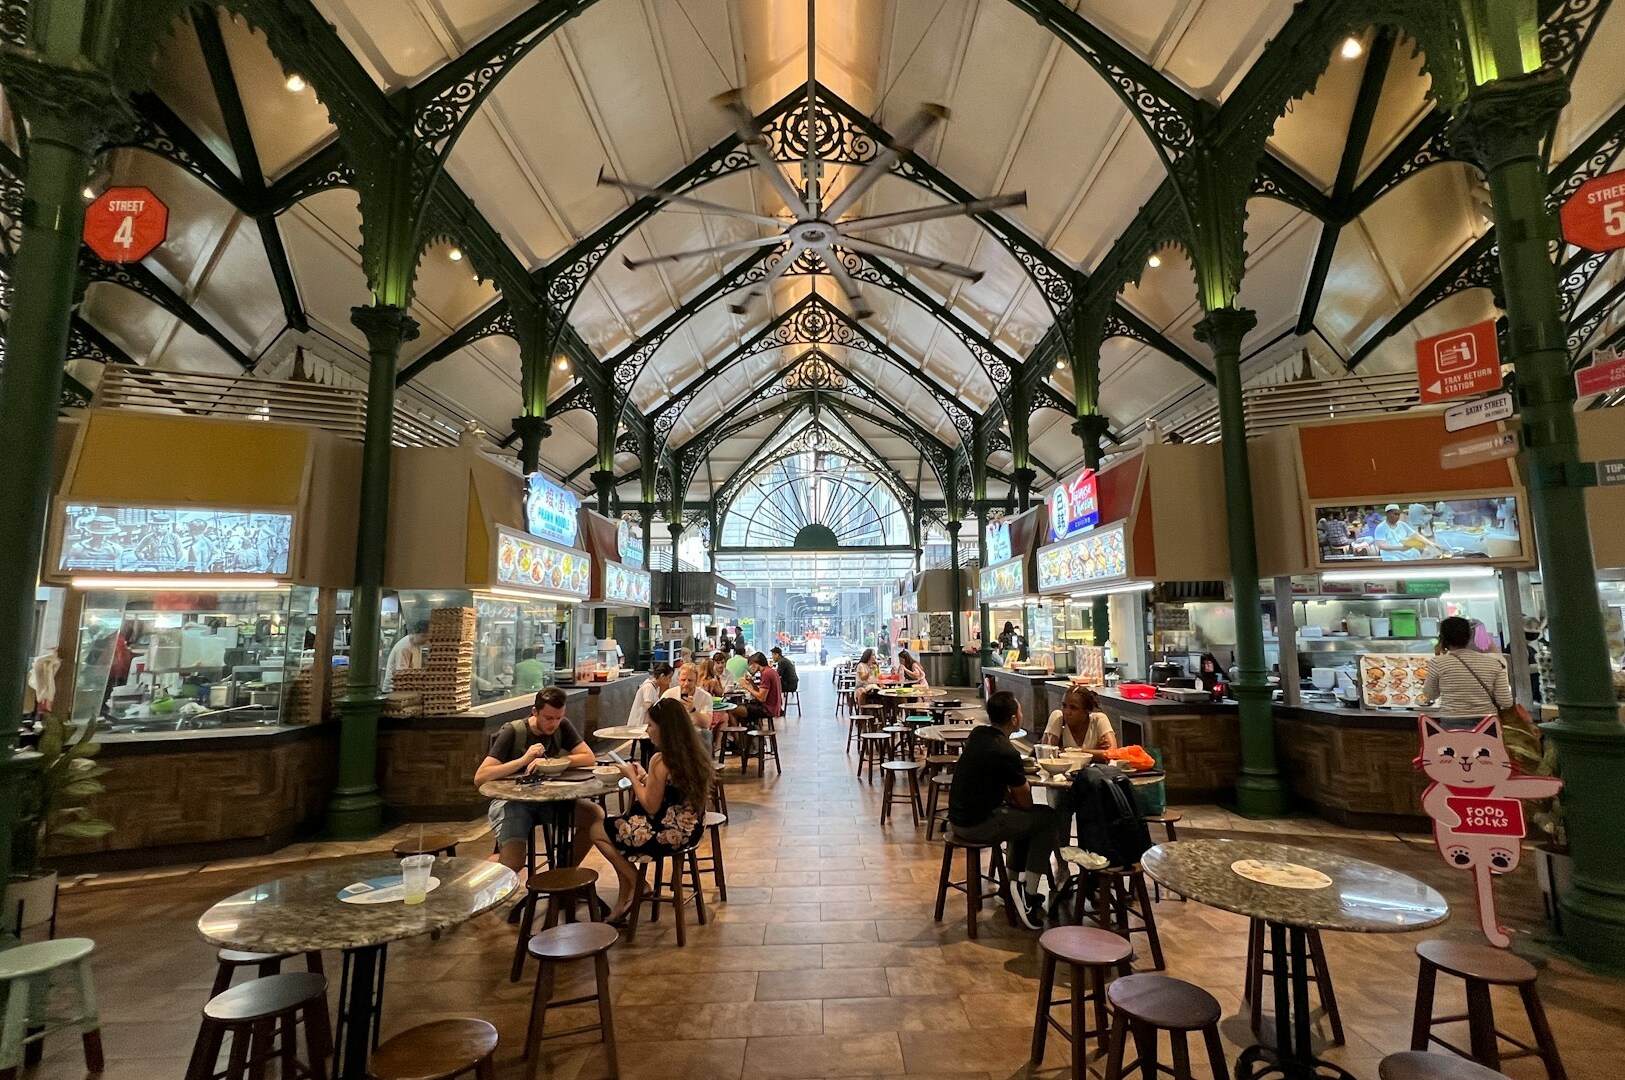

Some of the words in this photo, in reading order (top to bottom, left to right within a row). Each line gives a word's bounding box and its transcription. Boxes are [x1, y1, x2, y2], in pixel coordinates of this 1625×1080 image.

[108, 200, 145, 212] STREET
[1603, 200, 1625, 236] 5
[113, 215, 134, 249] 4
[1444, 375, 1462, 385] TRAY
[1463, 367, 1492, 381] RETURN
[1444, 380, 1475, 393] STATION
[1465, 403, 1483, 416] SATAY
[1484, 398, 1507, 411] STREET
[1466, 806, 1504, 818] FOOD
[1466, 816, 1509, 828] FOLKS
